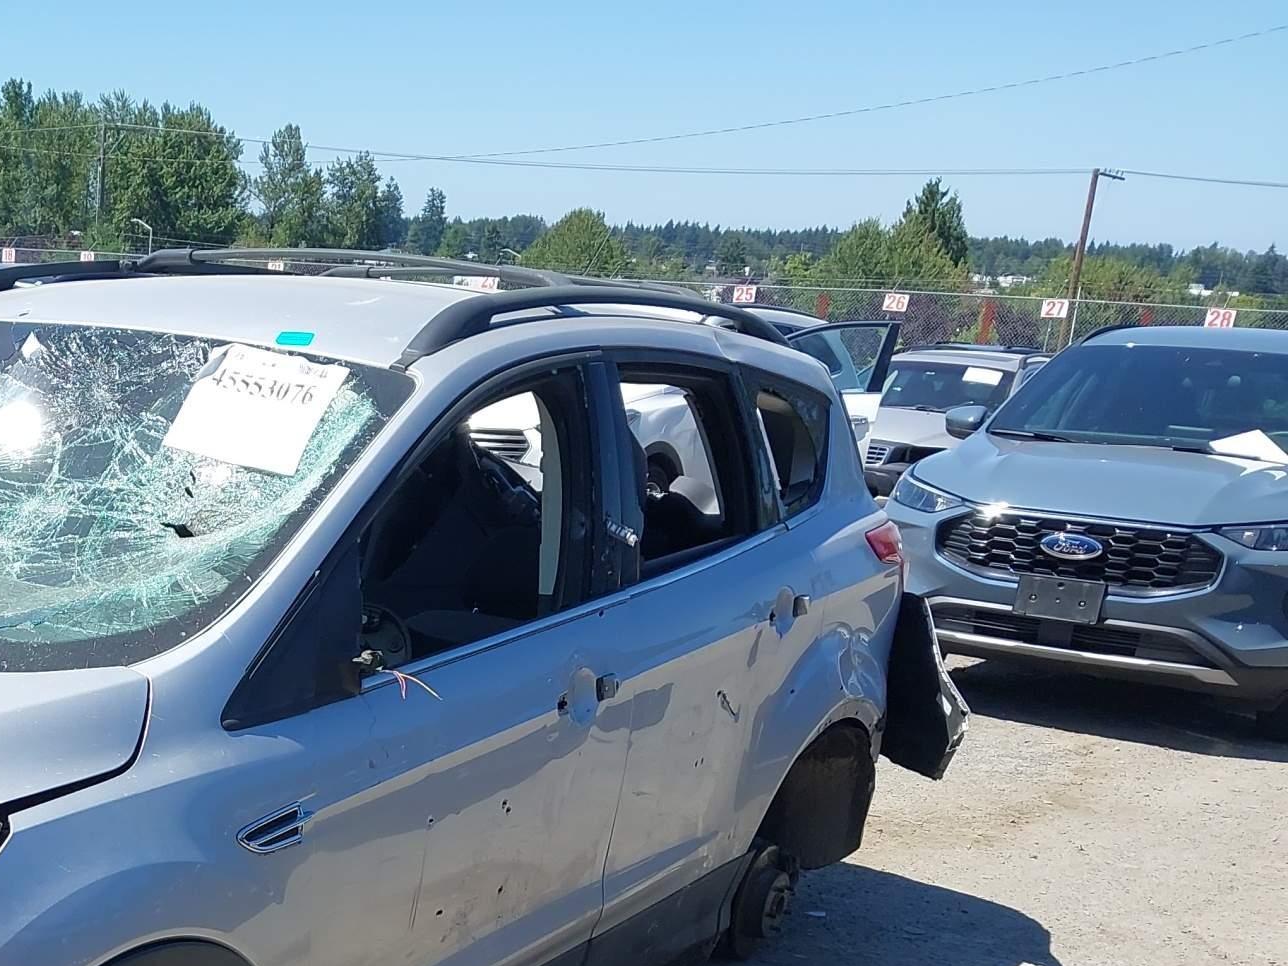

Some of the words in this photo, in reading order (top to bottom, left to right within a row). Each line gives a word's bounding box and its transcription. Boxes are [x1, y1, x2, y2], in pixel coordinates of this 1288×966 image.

[4, 248, 14, 260] 18
[735, 287, 754, 301] 25
[885, 296, 905, 310] 26
[1043, 301, 1065, 316] 27
[1207, 310, 1232, 327] 28
[212, 367, 318, 405] 45553076
